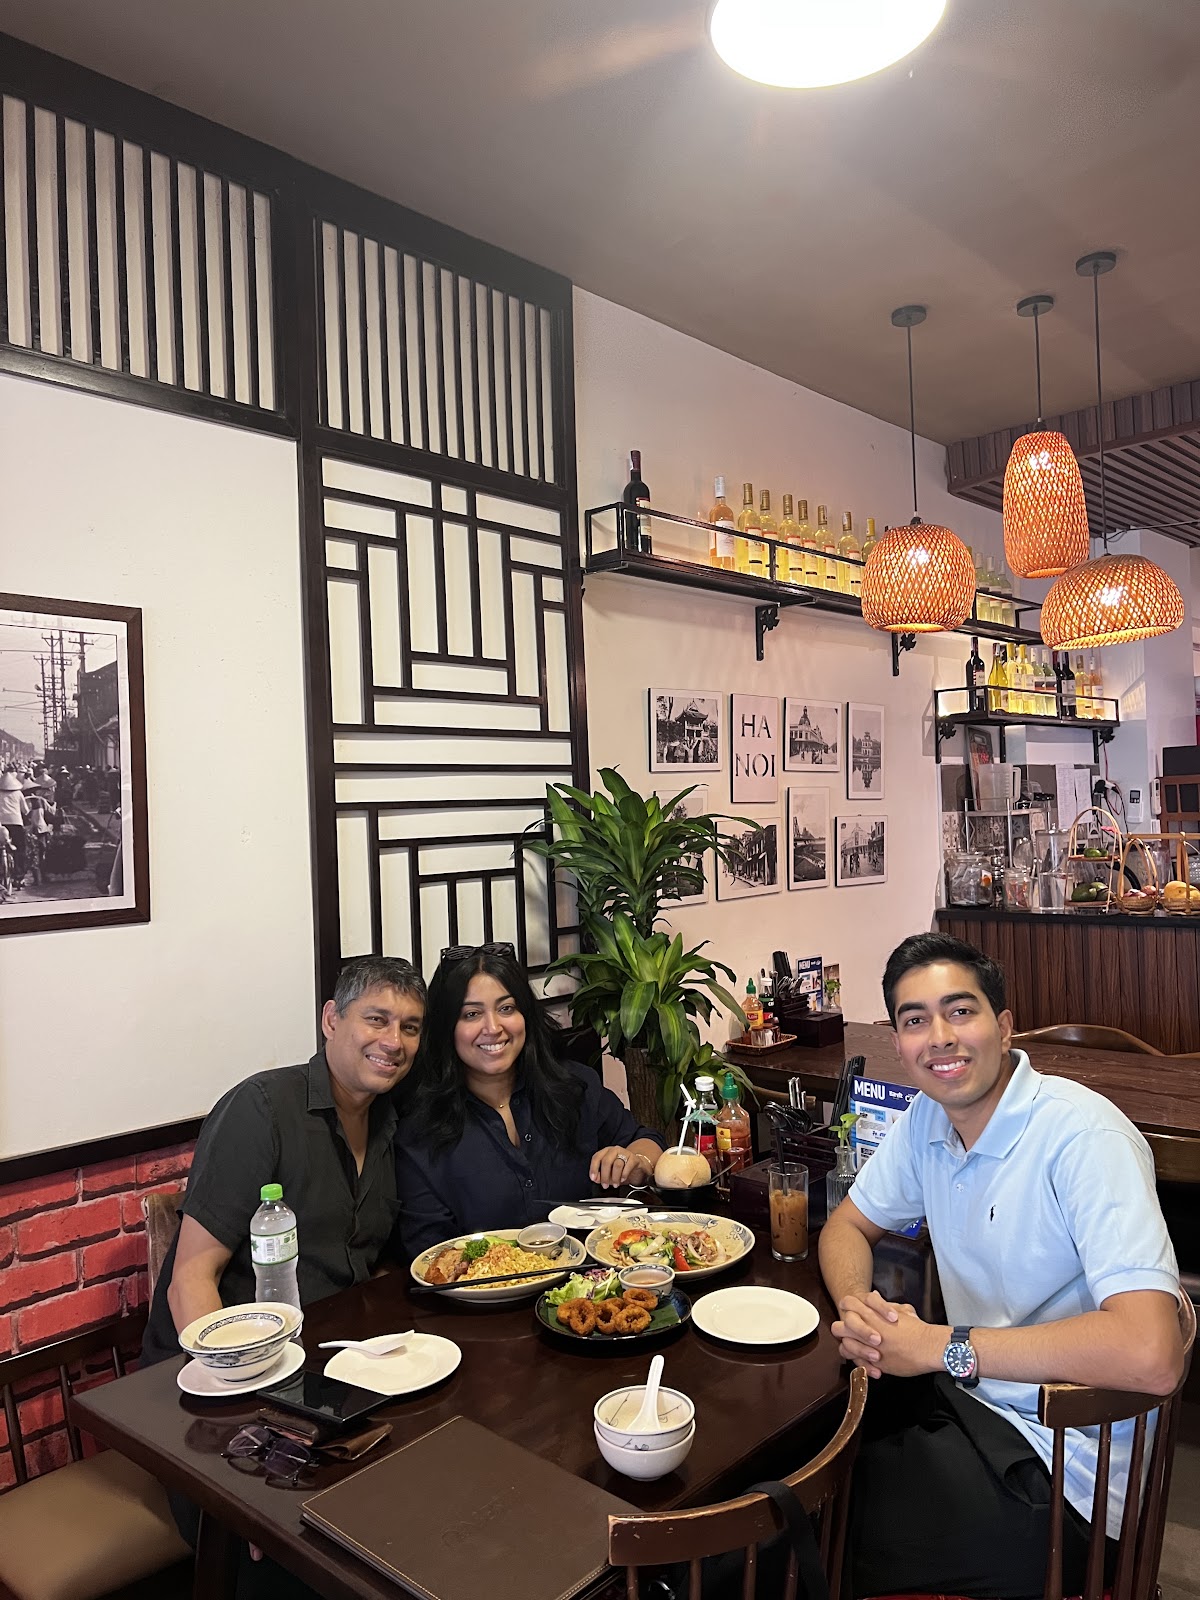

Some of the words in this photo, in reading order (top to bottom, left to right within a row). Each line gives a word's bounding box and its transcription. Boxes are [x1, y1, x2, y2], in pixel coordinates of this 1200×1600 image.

[741, 713, 772, 738] HA
[735, 753, 775, 778] NOI
[799, 960, 811, 970] MENU
[854, 1080, 886, 1100] MENU
